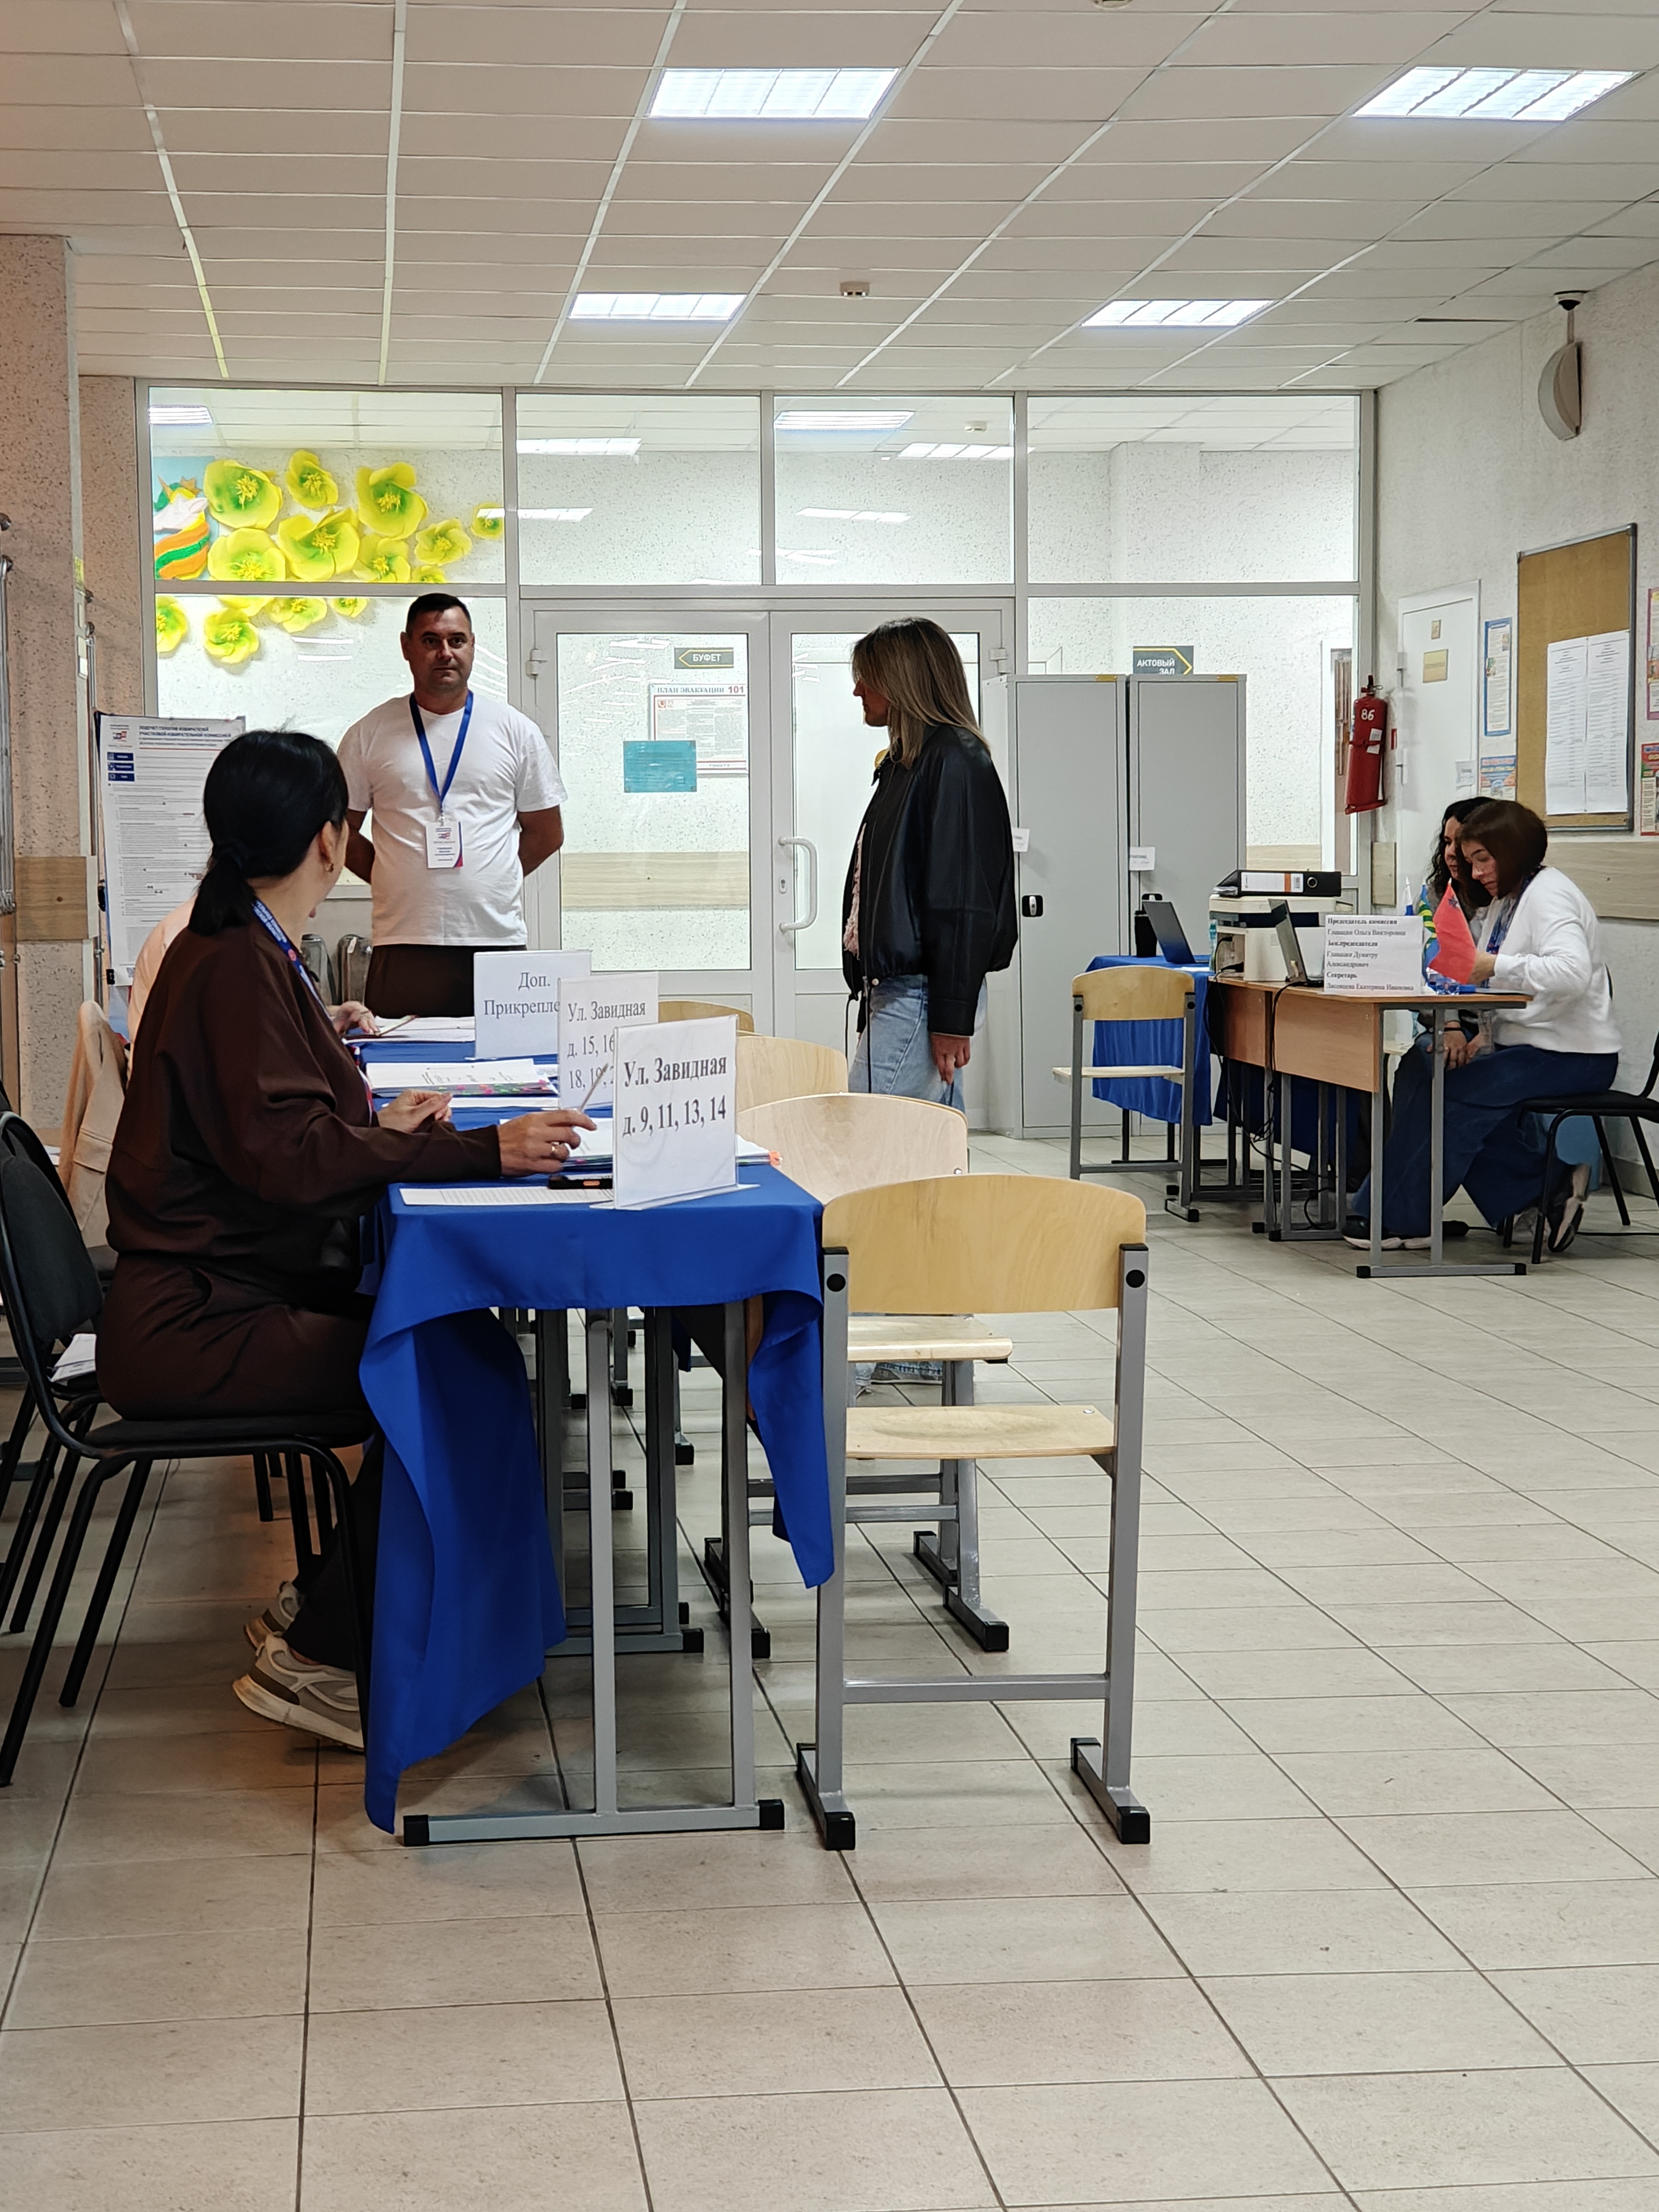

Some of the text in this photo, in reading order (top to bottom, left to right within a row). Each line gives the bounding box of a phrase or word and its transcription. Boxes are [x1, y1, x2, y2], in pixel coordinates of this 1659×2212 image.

[692, 653, 721, 662] БУФЕТ
[1136, 658, 1175, 667] АКТОВЫЙ
[728, 685, 744, 693] 101
[518, 972, 551, 990] Доп.
[568, 1001, 646, 1022] Ул. Завидная
[567, 1043, 578, 1058] д.
[583, 1035, 599, 1057] 15,
[569, 1069, 586, 1090] 18,
[623, 1061, 649, 1087] Ул.
[653, 1056, 727, 1083] Завидная
[622, 1094, 726, 1138] д. 9, 11, 13, 14
